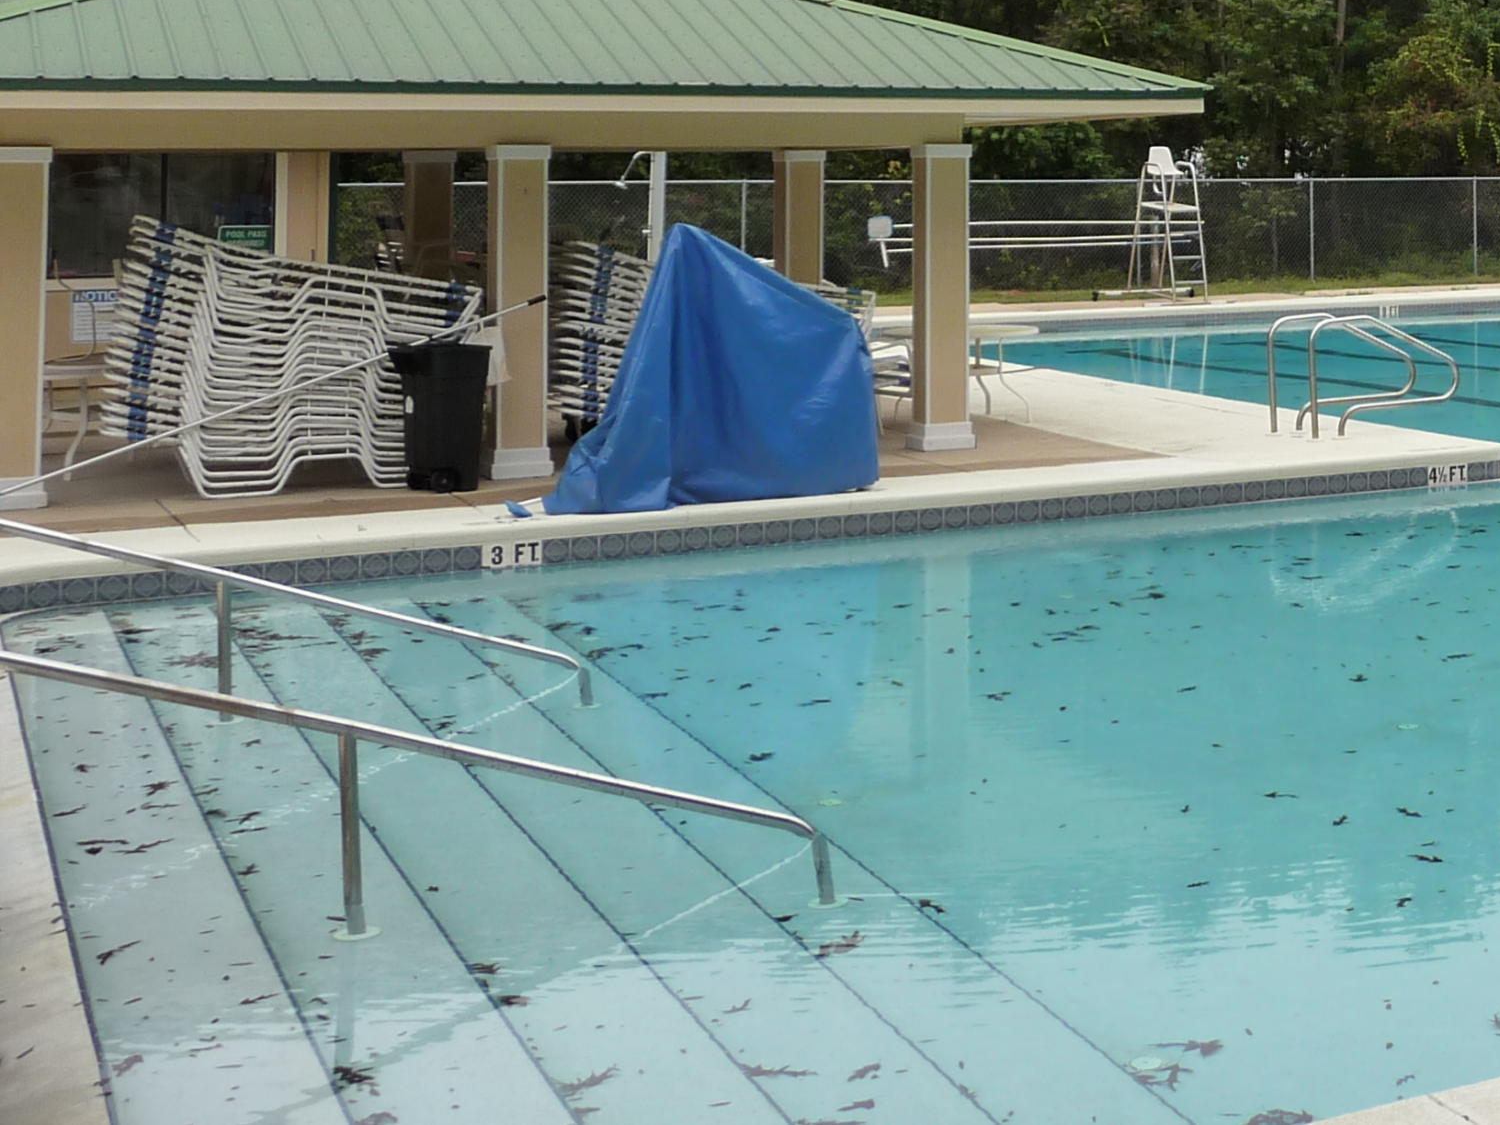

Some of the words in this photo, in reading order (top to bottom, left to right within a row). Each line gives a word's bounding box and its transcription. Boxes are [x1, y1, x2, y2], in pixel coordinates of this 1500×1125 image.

[1449, 465, 1466, 483] FT.
[491, 545, 503, 565] 3
[514, 541, 540, 564] FT.
